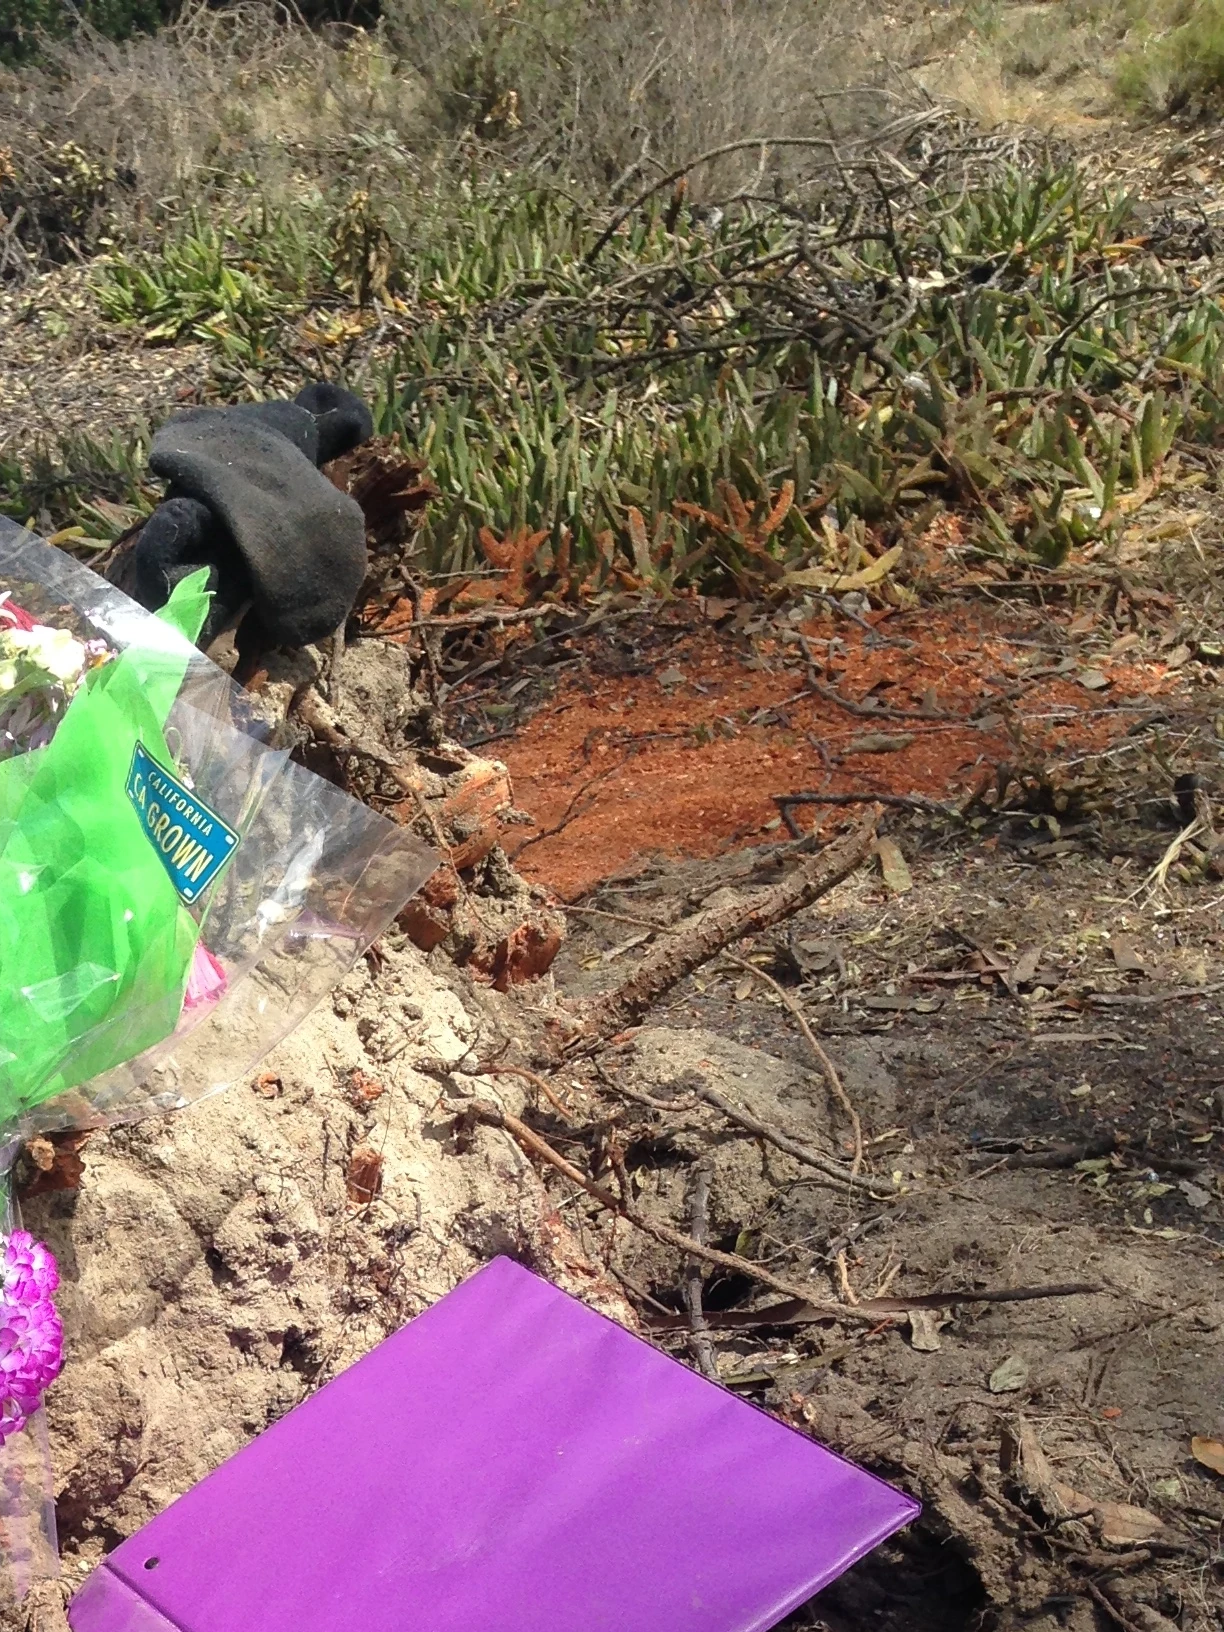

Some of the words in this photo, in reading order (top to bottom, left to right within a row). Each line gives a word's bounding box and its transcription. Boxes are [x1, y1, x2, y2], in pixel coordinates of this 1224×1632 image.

[134, 773, 146, 809] CA
[147, 802, 214, 883] GROWN
[148, 771, 213, 836] CALIFORNIA
